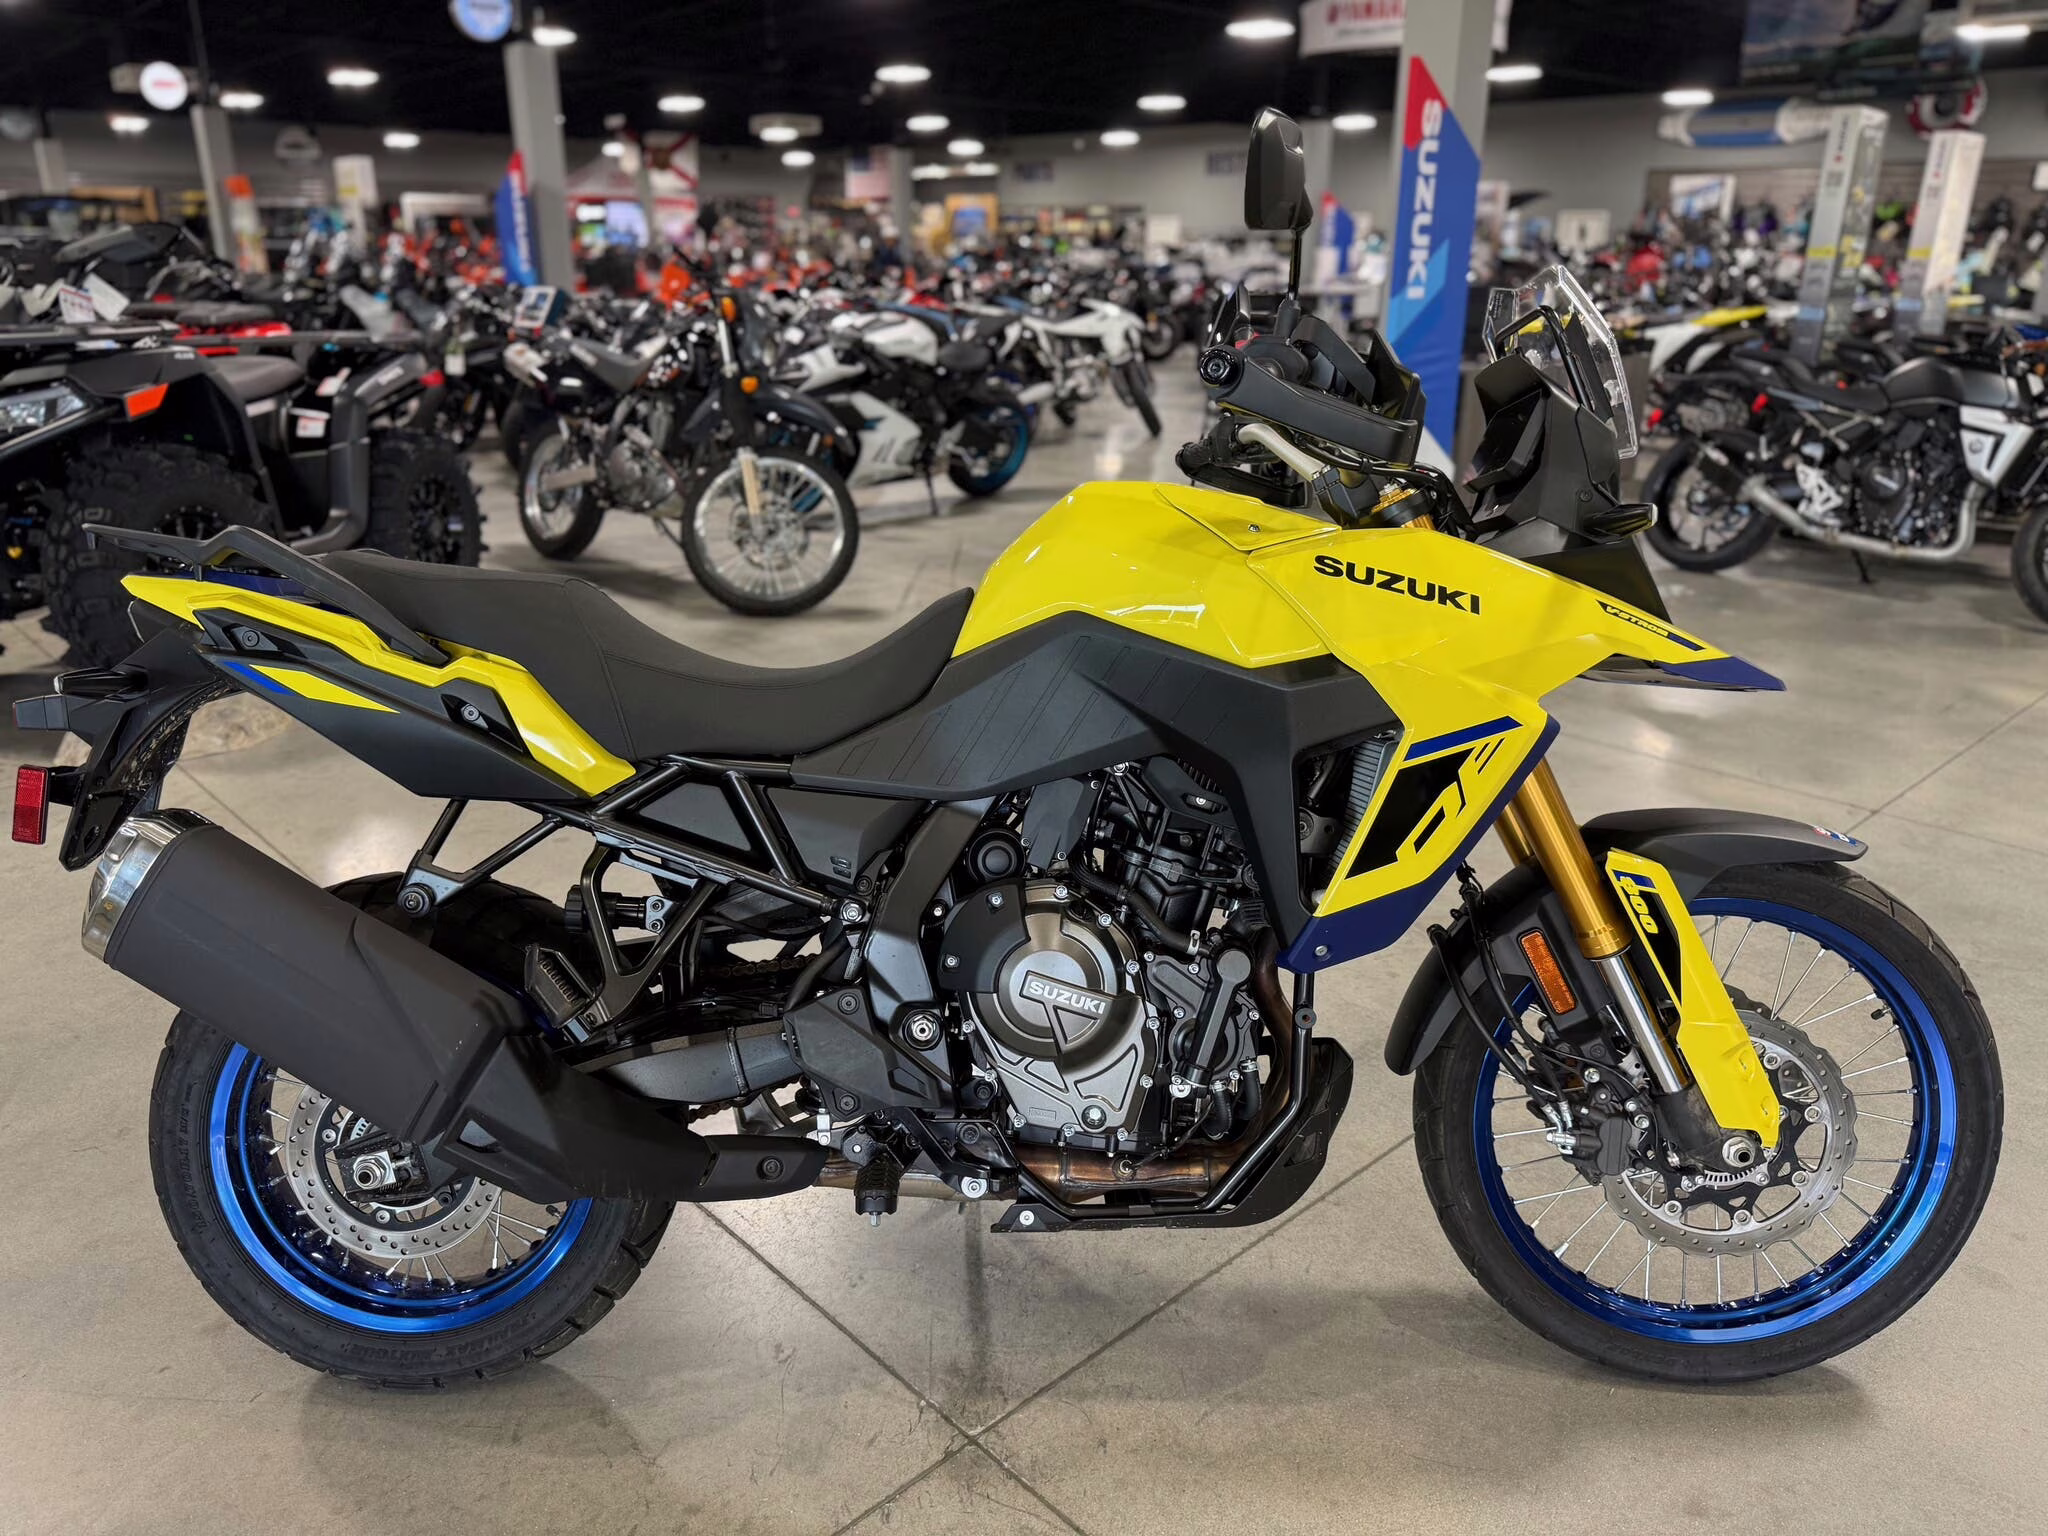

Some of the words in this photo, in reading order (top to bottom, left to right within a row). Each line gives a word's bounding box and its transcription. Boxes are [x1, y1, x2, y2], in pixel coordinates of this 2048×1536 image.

[1406, 97, 1443, 300] SUZUKI
[1313, 554, 1481, 616] SUZUKI
[1618, 875, 1659, 934] 800
[1028, 980, 1106, 1015] SUZUKI
